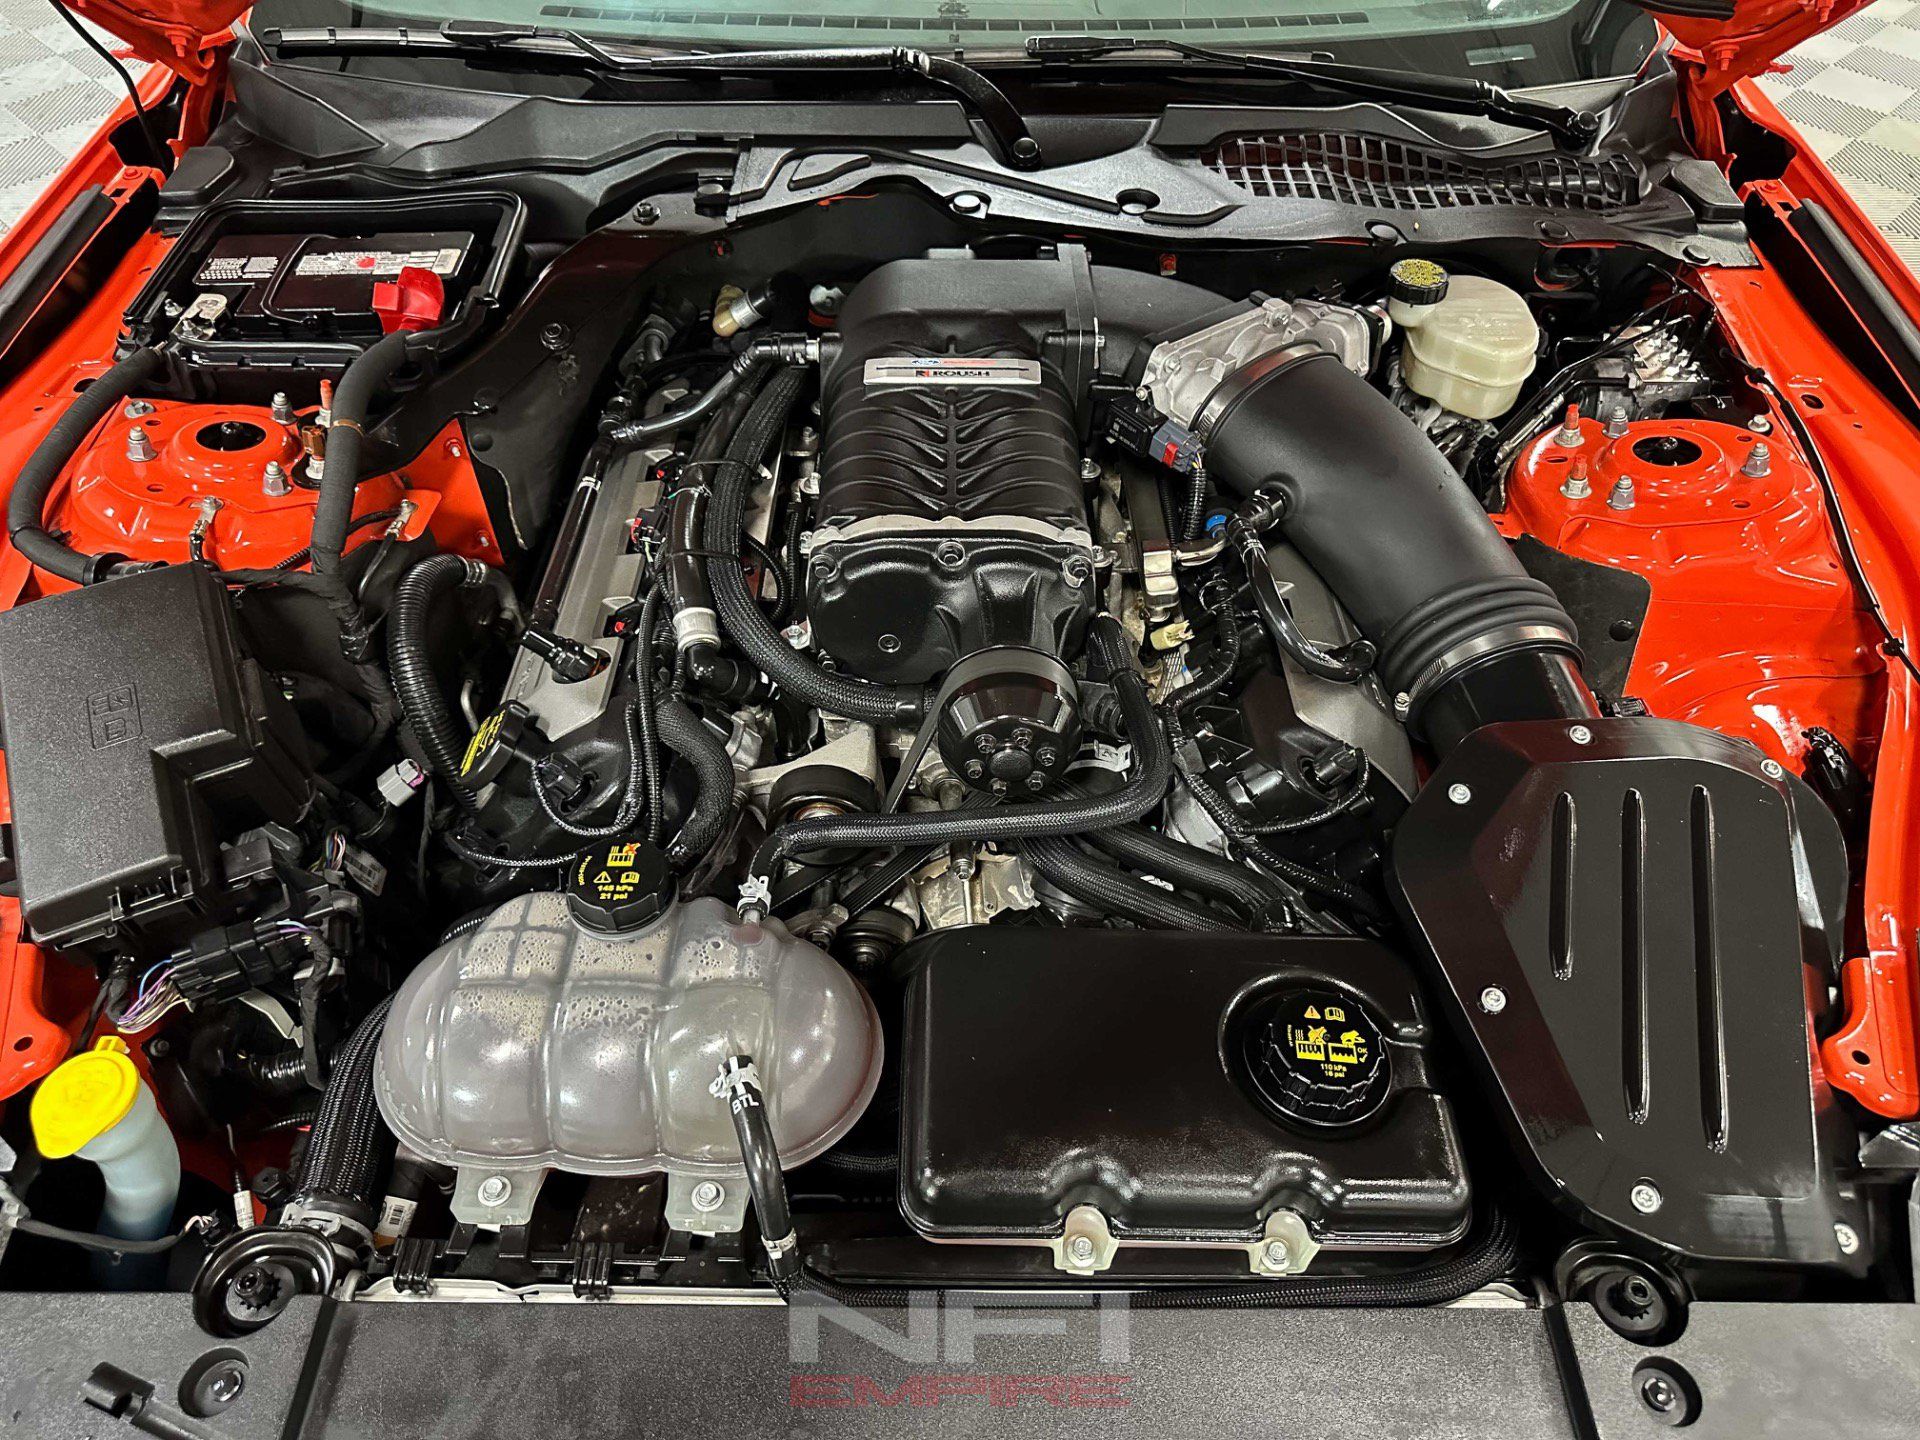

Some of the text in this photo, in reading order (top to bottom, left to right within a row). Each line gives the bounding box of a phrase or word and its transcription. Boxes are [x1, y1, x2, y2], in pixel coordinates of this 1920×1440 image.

[613, 893, 628, 901] psi
[1333, 1064, 1347, 1072] kPa
[732, 1093, 759, 1114] BTL
